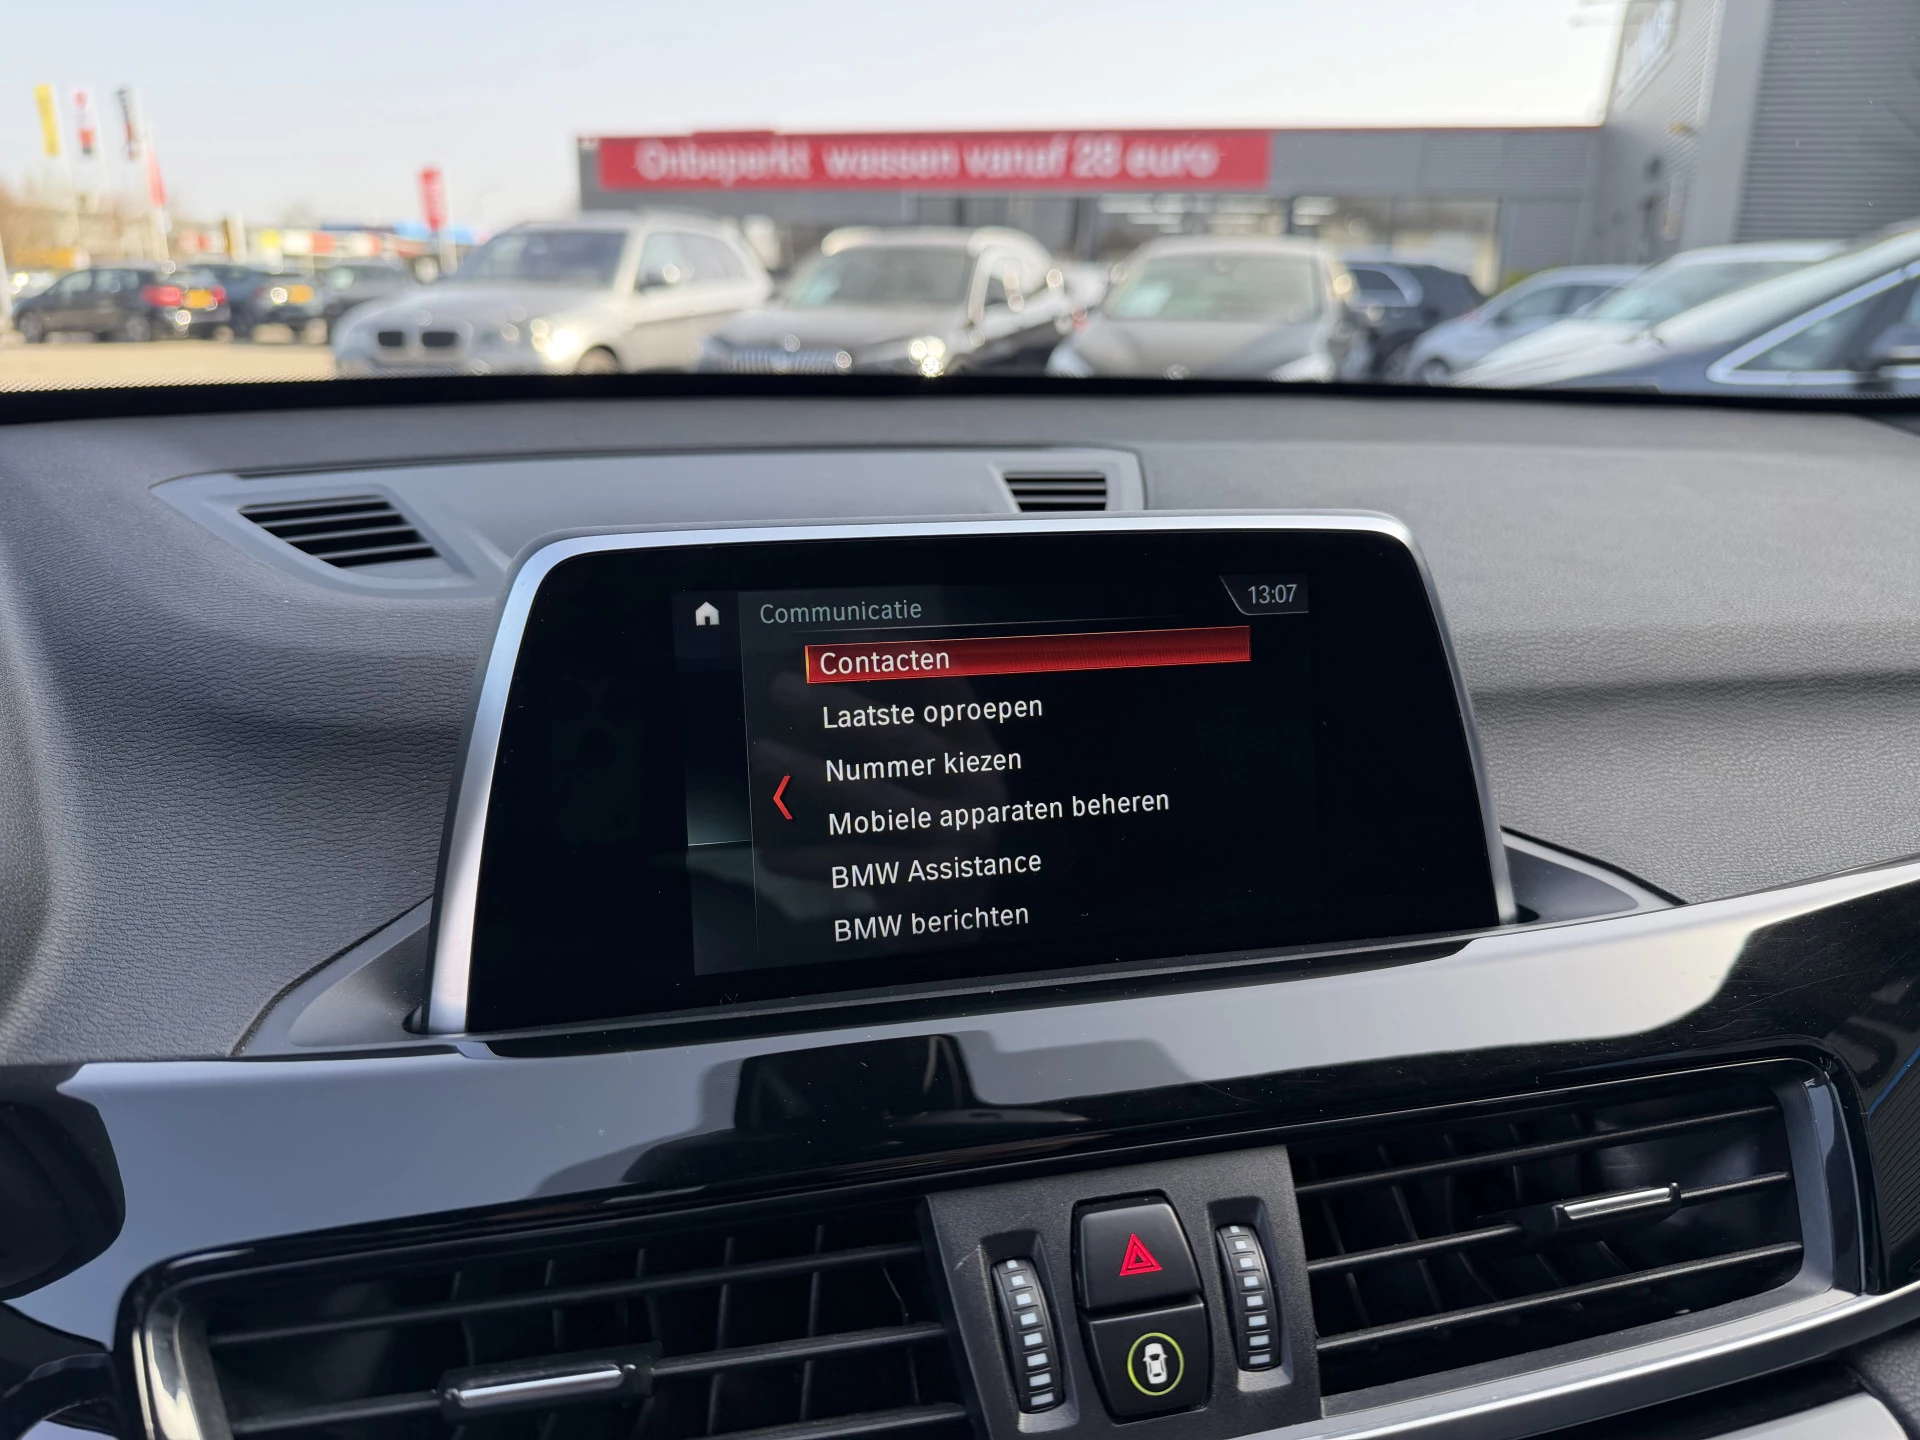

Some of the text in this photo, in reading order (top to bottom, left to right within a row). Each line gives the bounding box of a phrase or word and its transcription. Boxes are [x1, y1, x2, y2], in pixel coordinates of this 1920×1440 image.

[822, 143, 960, 180] wassen
[963, 135, 1069, 180] vanaf
[1070, 133, 1122, 179] 28
[1125, 140, 1220, 179] euro
[1247, 583, 1298, 606] 13:07
[759, 599, 923, 626] Communicatie
[819, 646, 951, 676] Contacten
[822, 697, 1044, 730] Laatste oproepen
[826, 750, 1023, 783] Nummer kiezen
[828, 791, 1170, 837] Mobiele apparaten beheren
[831, 853, 1043, 890] BMW Assistance
[834, 905, 1030, 943] BMW berichten
